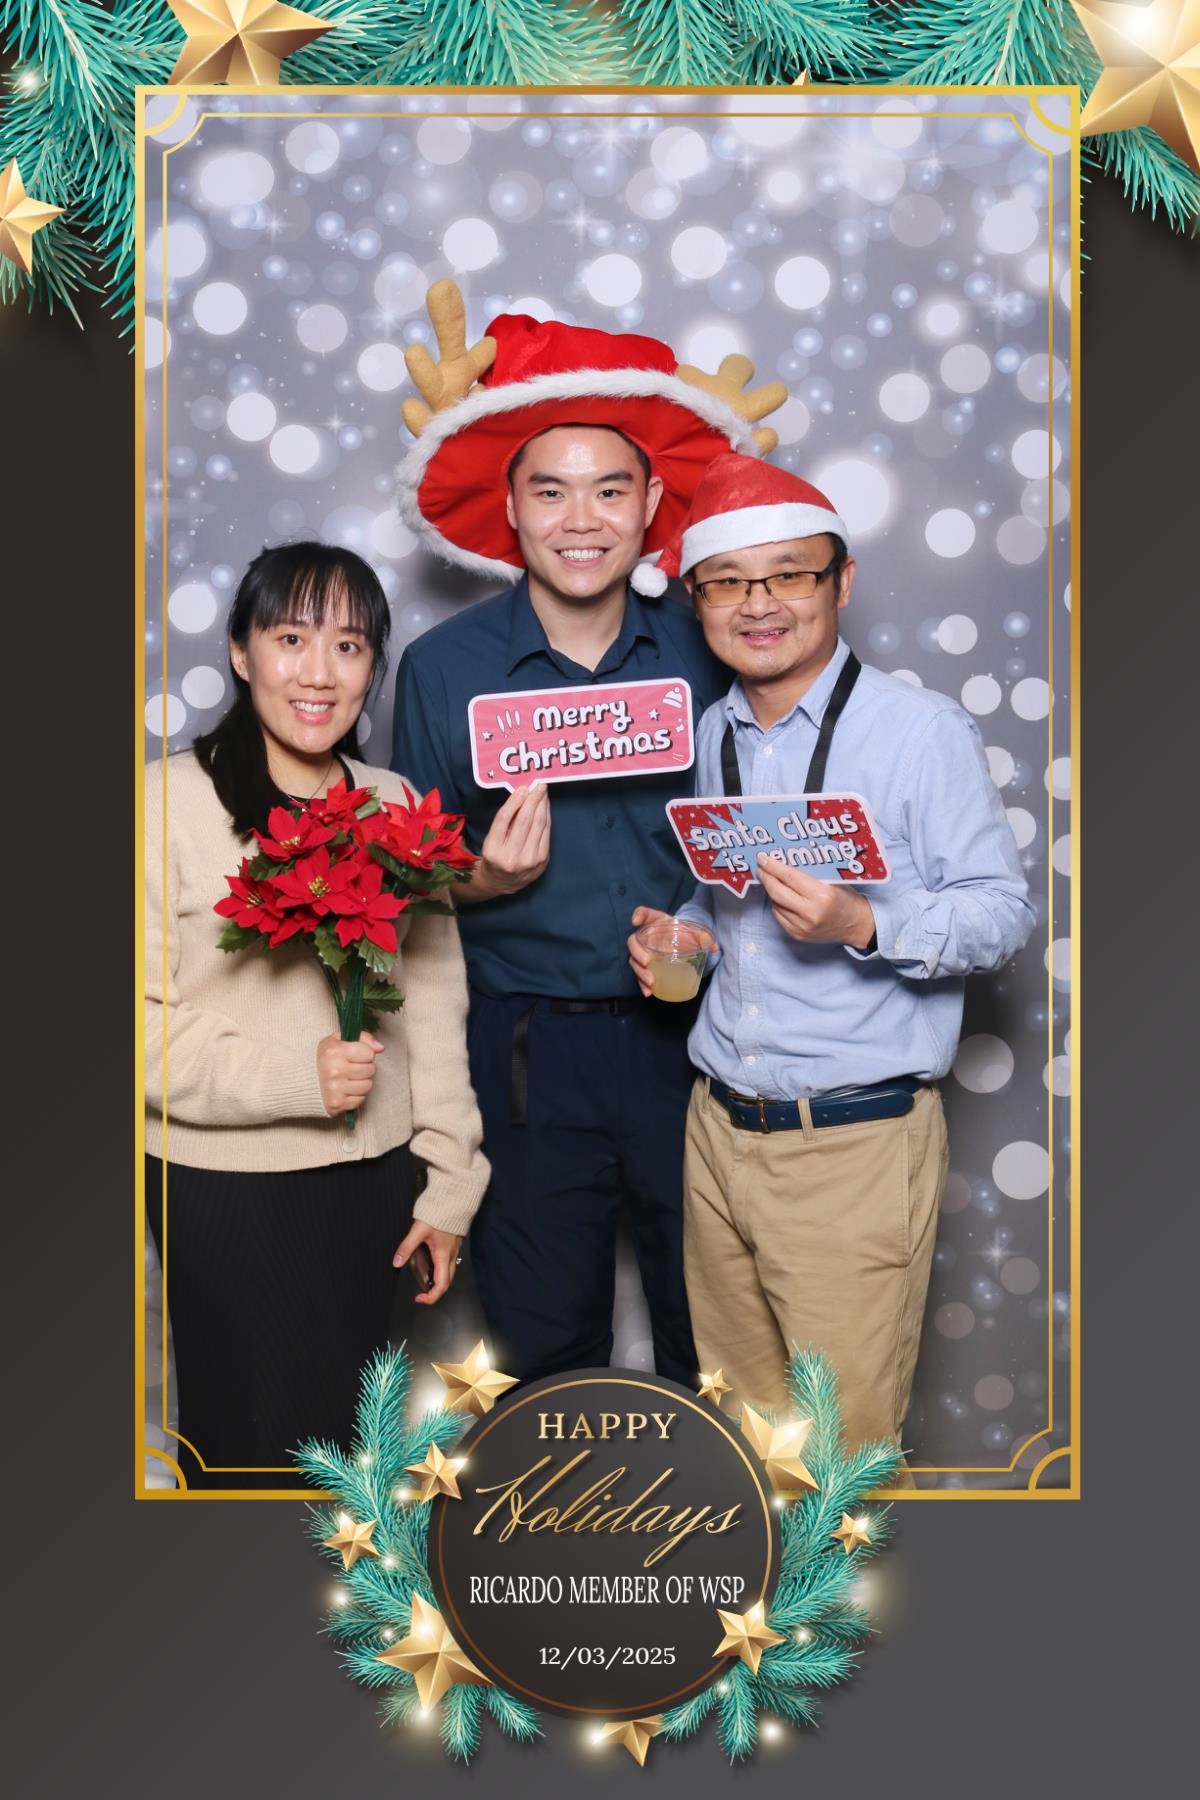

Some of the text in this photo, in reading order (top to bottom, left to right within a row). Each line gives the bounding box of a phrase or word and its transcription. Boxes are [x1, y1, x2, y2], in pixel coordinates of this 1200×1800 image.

[532, 700, 632, 732] Merry
[499, 728, 672, 773] Christmas
[690, 811, 859, 851] Santa Claus
[723, 838, 865, 874] is oming
